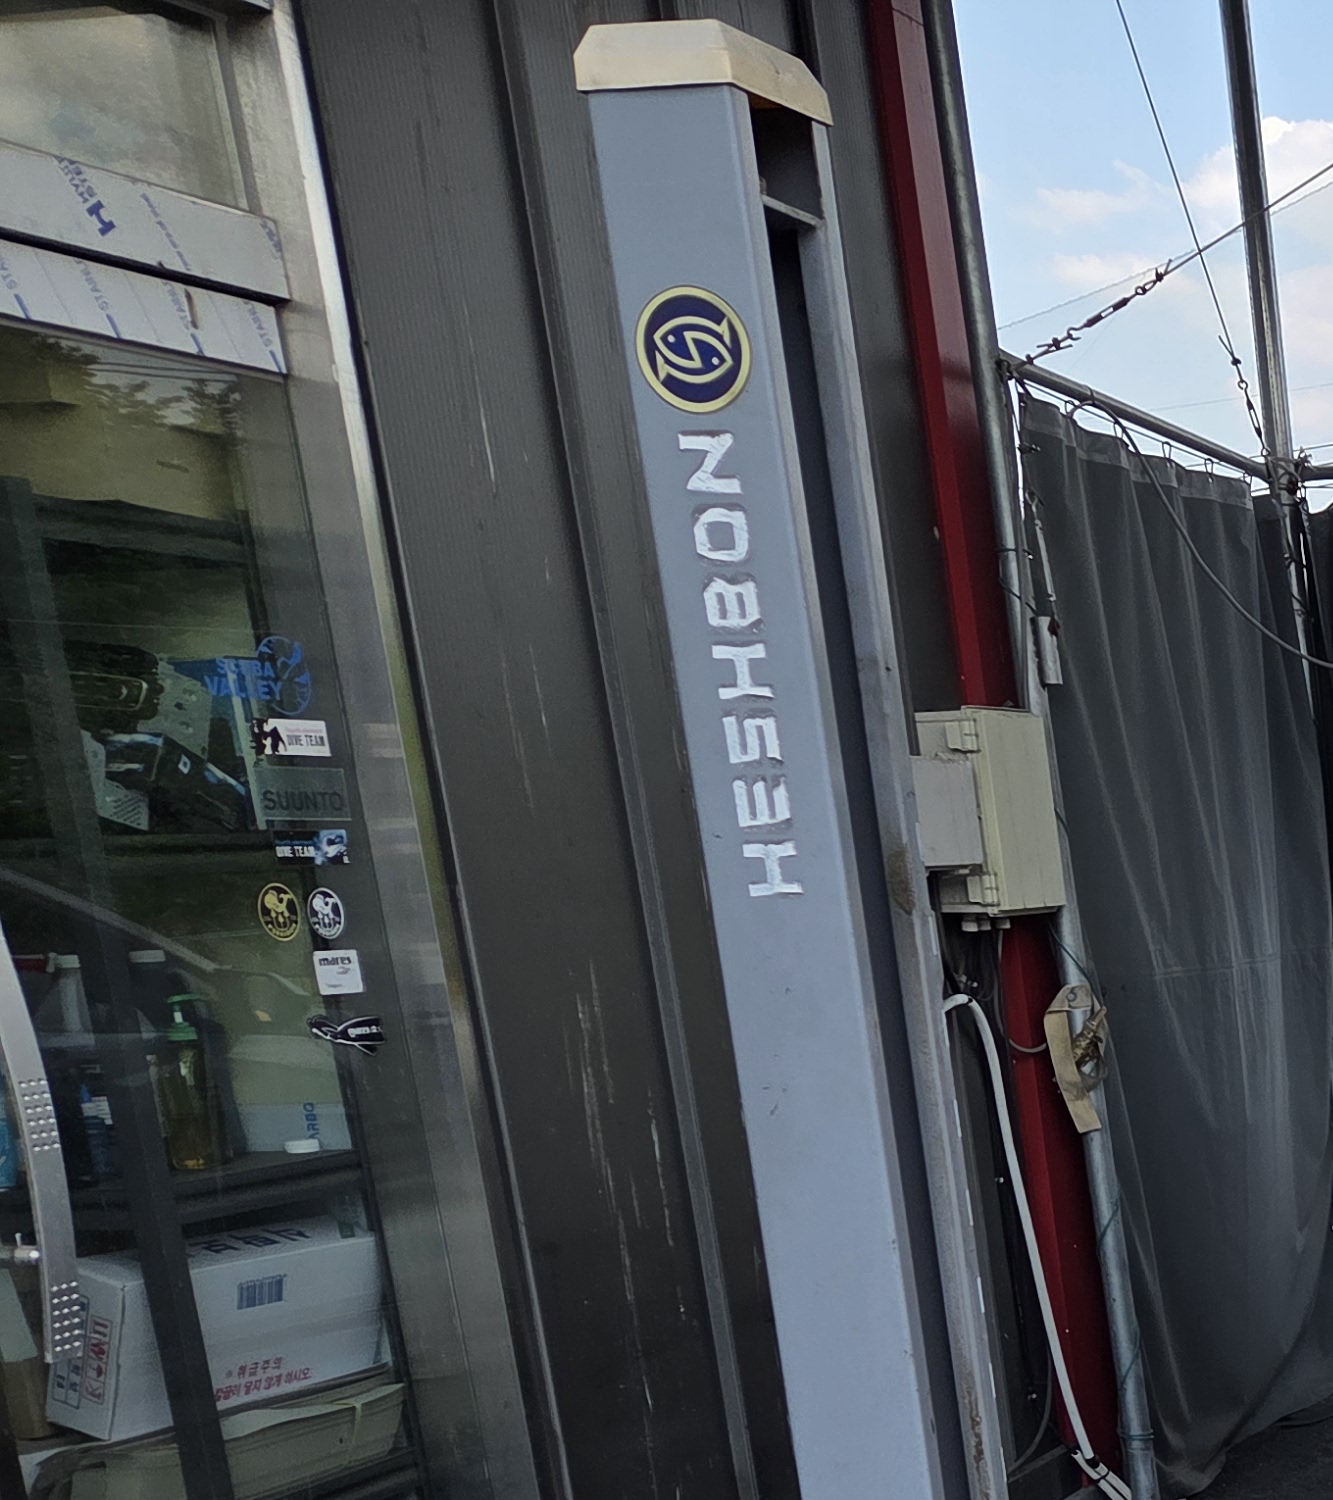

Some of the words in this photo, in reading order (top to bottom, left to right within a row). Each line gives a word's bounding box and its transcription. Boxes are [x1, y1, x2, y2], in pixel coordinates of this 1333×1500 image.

[677, 430, 804, 898] HESHBON
[203, 675, 283, 701] VALLEY
[262, 789, 345, 812] SUUNTO
